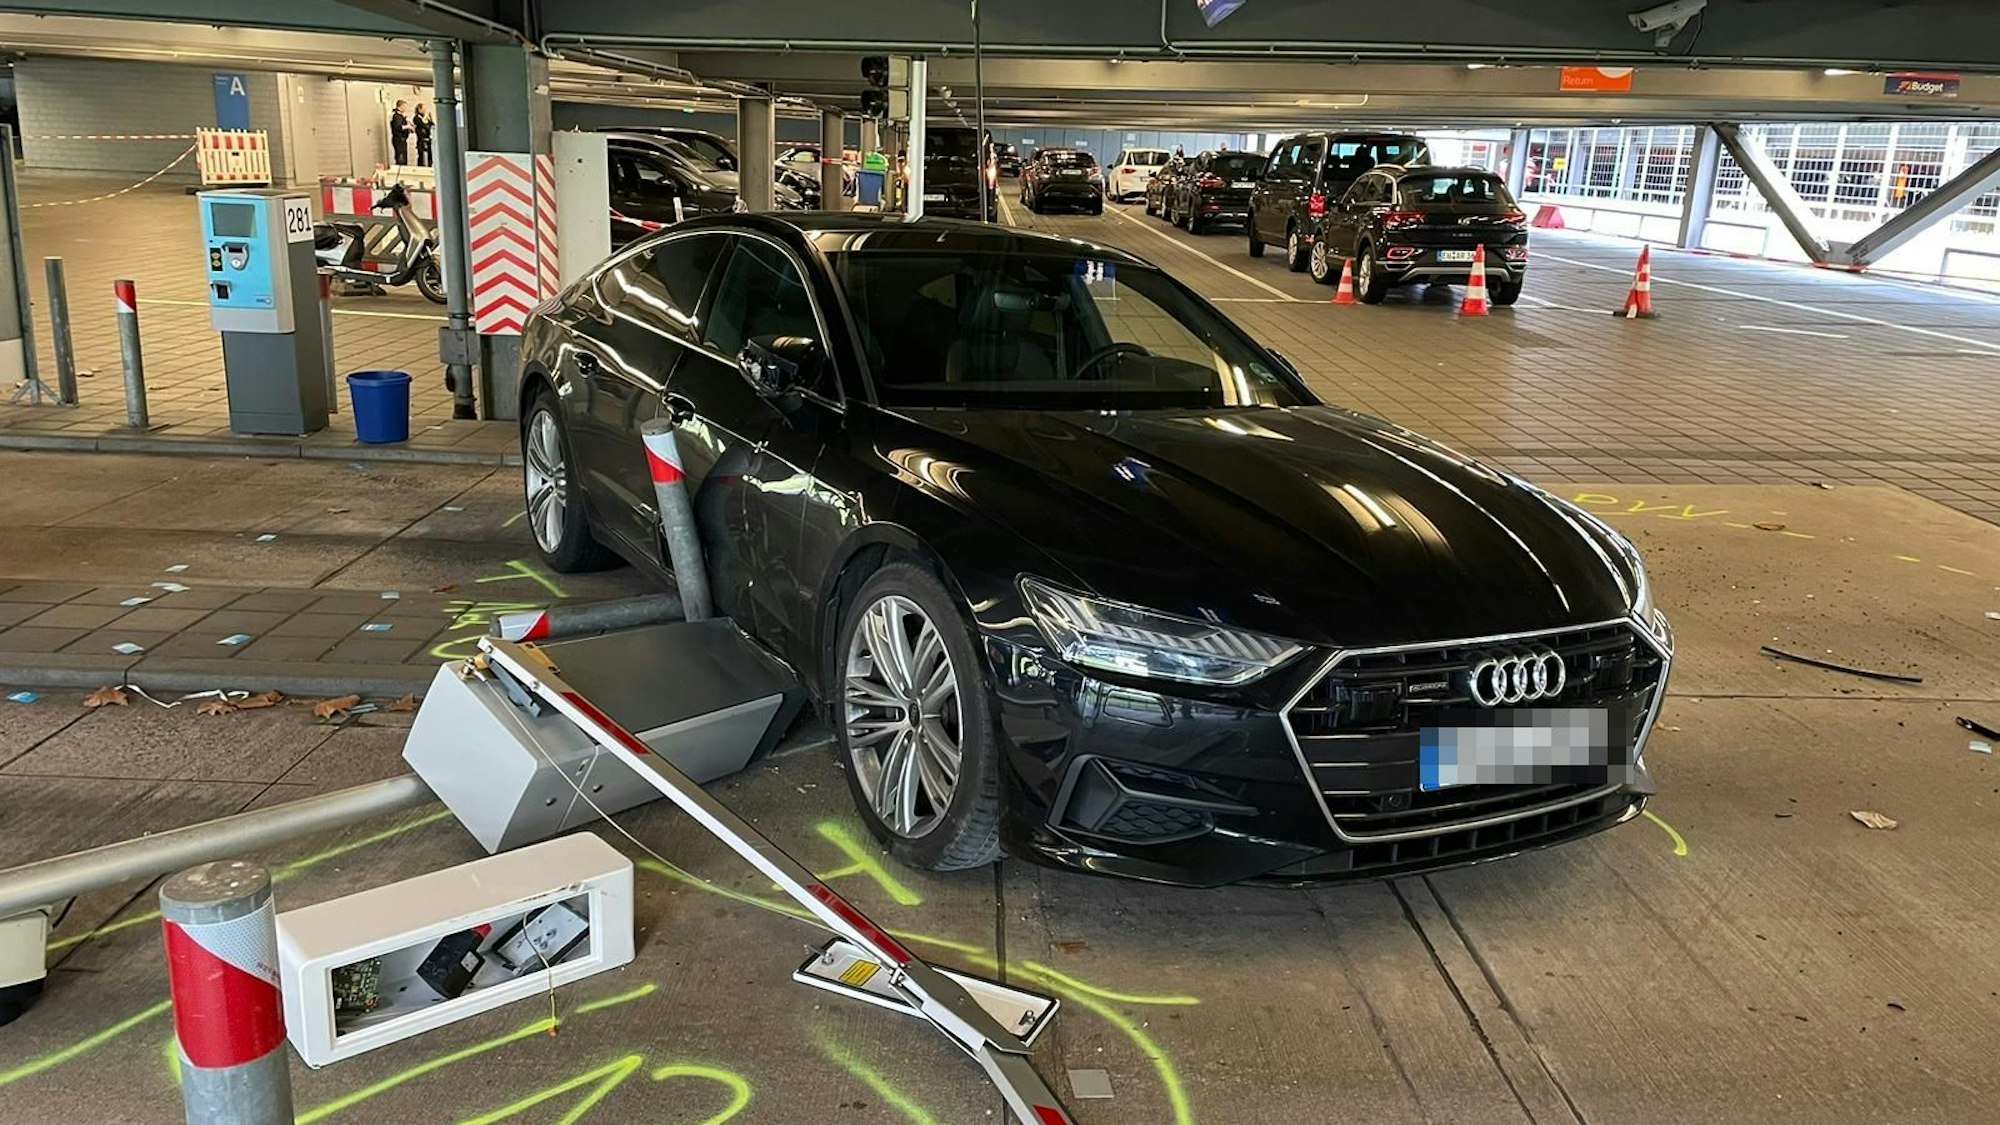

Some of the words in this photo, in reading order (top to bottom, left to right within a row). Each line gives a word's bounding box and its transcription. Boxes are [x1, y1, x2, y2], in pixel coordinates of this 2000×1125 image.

[230, 76, 246, 96] A
[1911, 81, 1944, 94] Budget
[288, 207, 311, 233] 281
